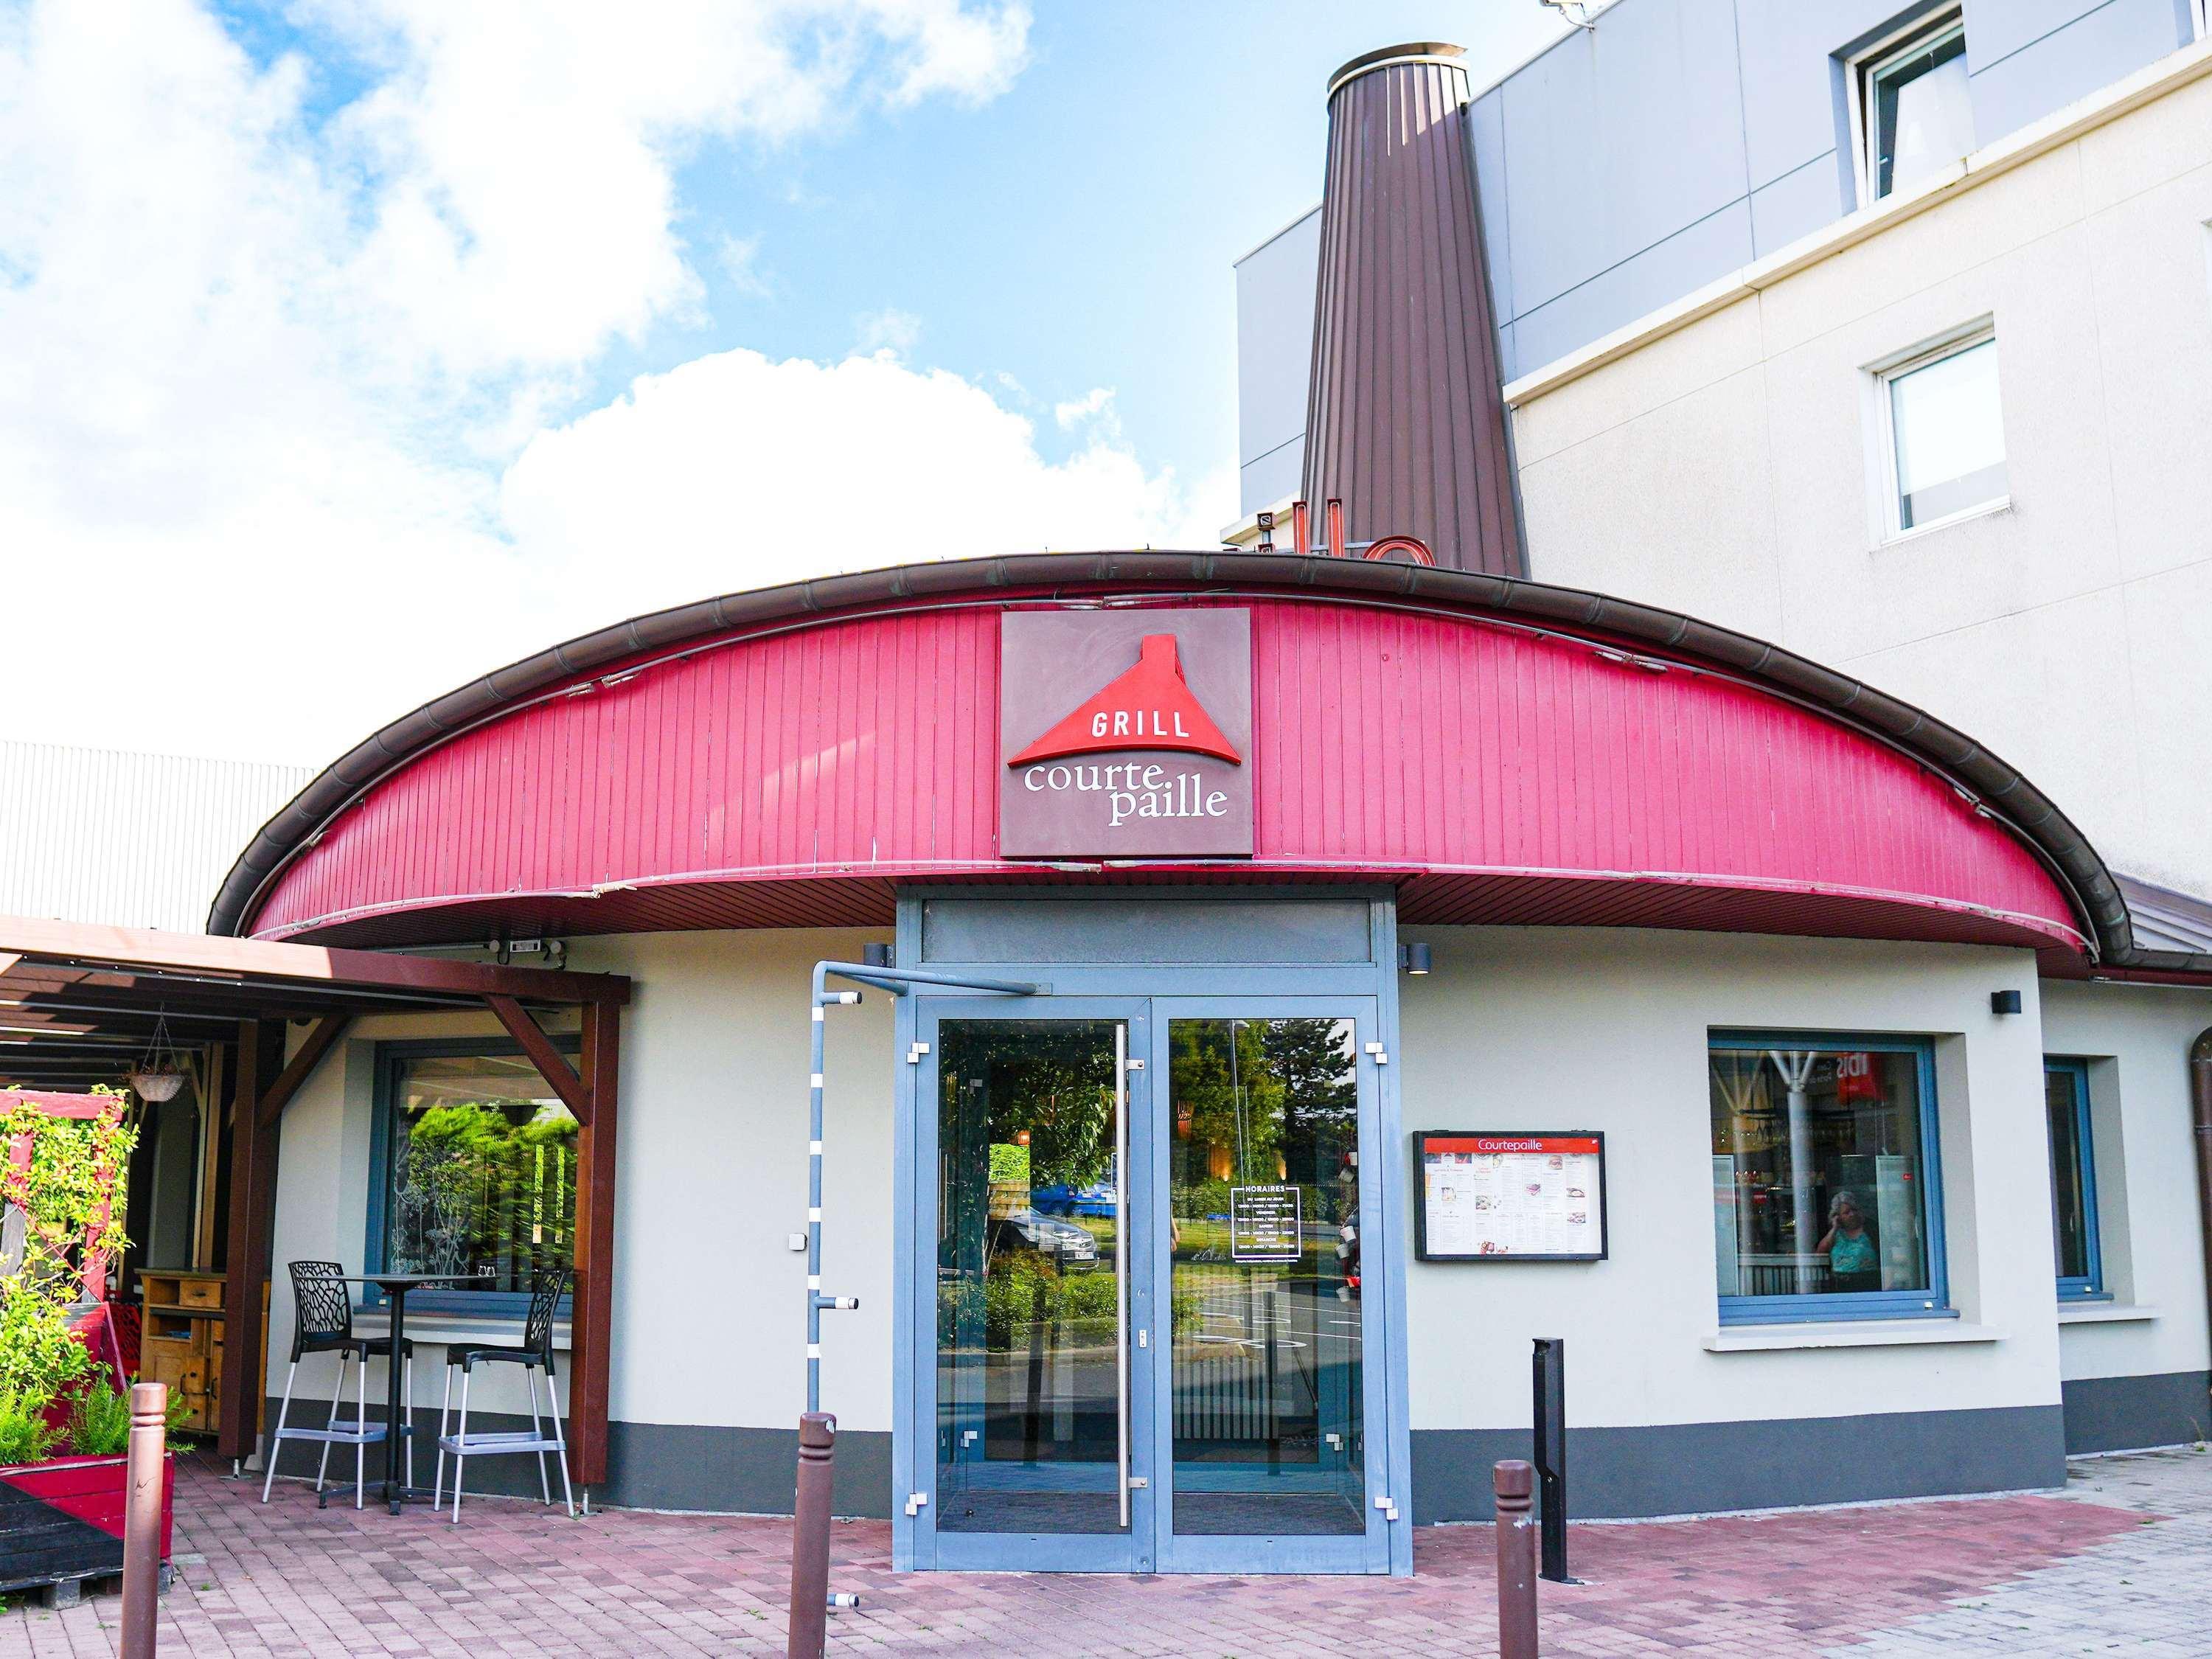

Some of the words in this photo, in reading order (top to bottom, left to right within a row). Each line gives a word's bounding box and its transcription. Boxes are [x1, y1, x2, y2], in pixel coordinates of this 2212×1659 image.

[1091, 709, 1190, 738] GRILL
[1023, 761, 1165, 792] courte
[1107, 772, 1228, 827] paille
[1478, 1138, 1543, 1152] Courtepaille
